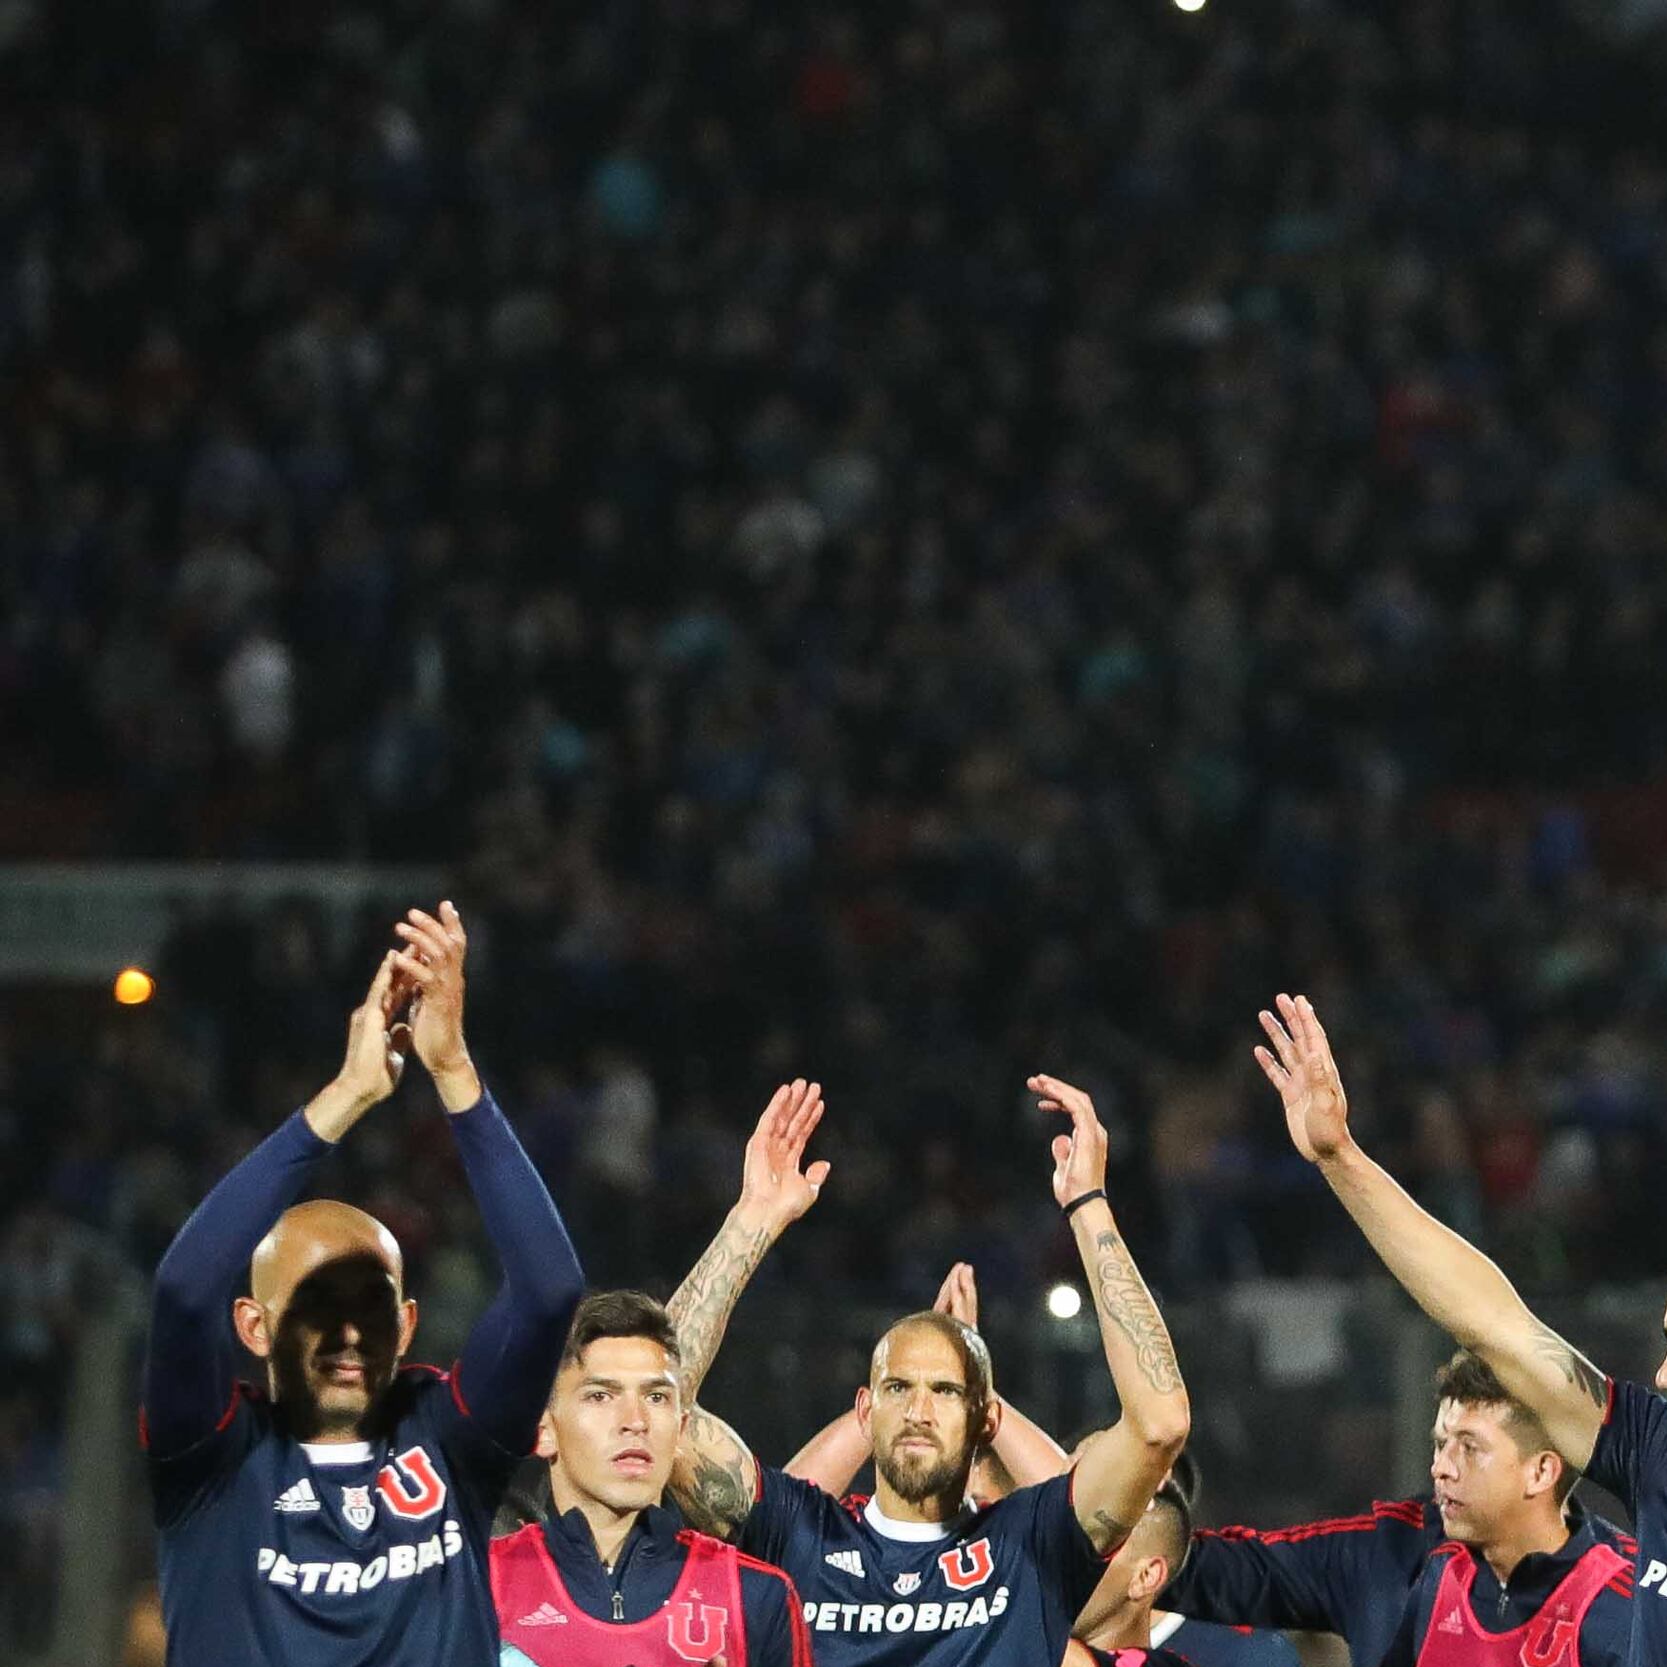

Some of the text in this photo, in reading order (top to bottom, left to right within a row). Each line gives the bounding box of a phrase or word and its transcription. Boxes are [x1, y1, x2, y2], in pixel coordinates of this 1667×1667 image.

[376, 1445, 448, 1519] U
[937, 1536, 995, 1592] U
[803, 1585, 1010, 1633] PETROBRAS
